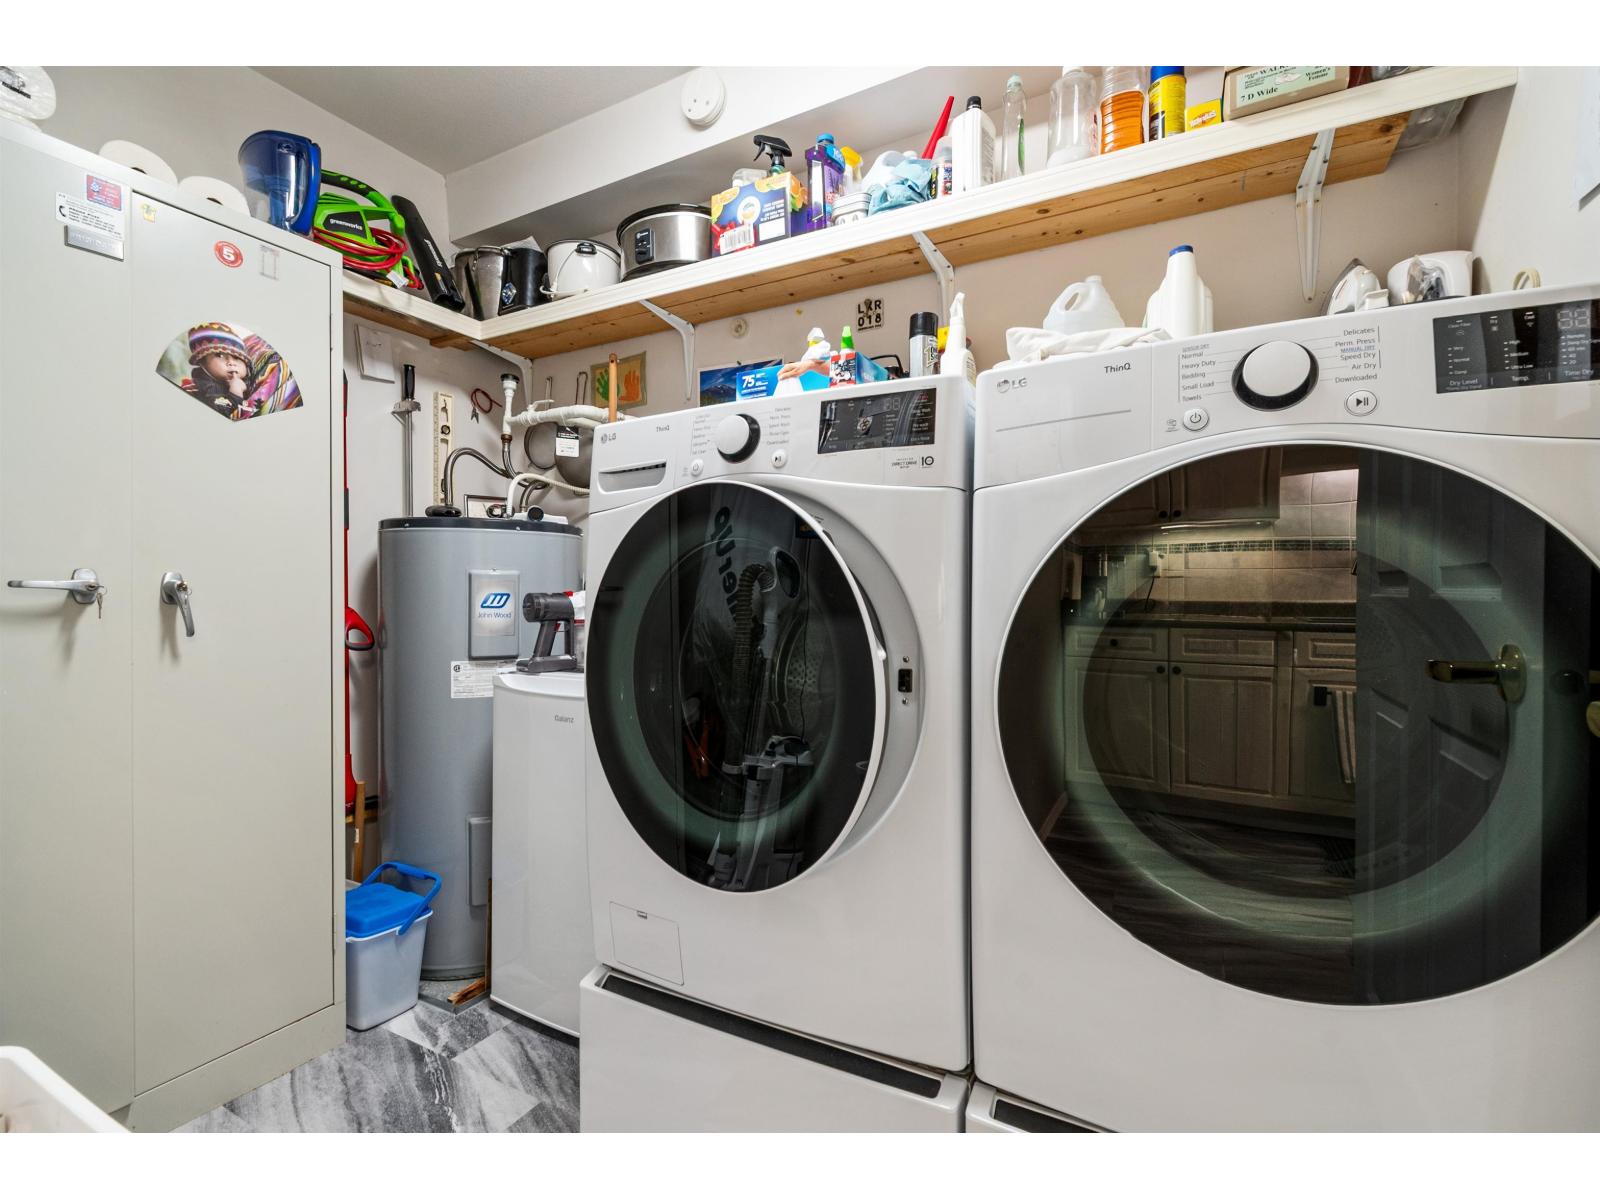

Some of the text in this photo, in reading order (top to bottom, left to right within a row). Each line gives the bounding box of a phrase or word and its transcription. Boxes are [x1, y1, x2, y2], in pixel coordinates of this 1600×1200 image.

[1305, 67, 1331, 77] Women's
[1248, 93, 1254, 101] D
[1257, 86, 1278, 97] Wide
[329, 218, 363, 231] greenworks
[858, 312, 882, 327] 018
[1343, 327, 1375, 336] Delicates
[1182, 351, 1204, 359] Normal
[1340, 352, 1376, 361] Speed Dry
[1104, 362, 1131, 374] ThinQ
[1181, 362, 1200, 370] Heavy
[1364, 362, 1377, 370] Dry
[1182, 372, 1206, 380] Bedding
[1582, 369, 1594, 377] Dry
[741, 374, 755, 389] 75
[1335, 373, 1378, 383] Downloaded
[1182, 383, 1199, 391] Small
[1182, 394, 1202, 402] Towels
[554, 714, 575, 724] Galanz
